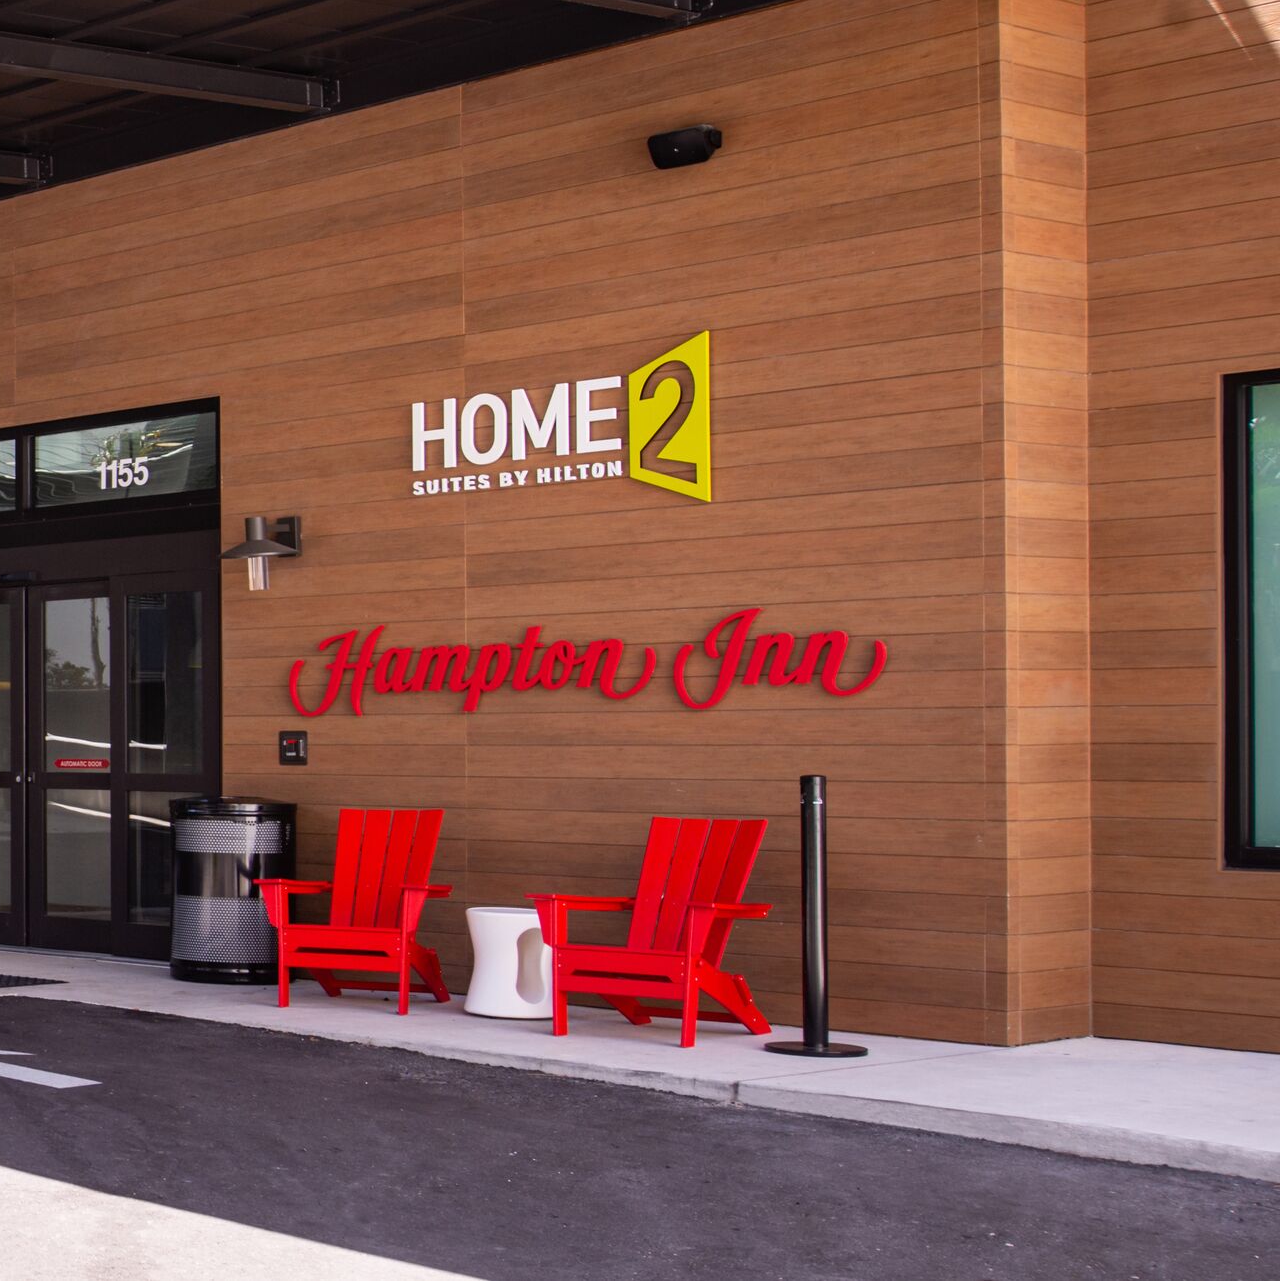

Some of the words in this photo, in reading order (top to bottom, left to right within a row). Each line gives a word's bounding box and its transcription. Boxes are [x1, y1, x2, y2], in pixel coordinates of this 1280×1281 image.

[411, 375, 622, 472] HOME
[639, 359, 698, 486] 2
[97, 456, 149, 490] 1155
[412, 473, 491, 496] SUITES
[499, 469, 529, 488] BY
[536, 460, 623, 485] HILTON
[288, 624, 656, 717] Hampton
[673, 607, 888, 711] Inn
